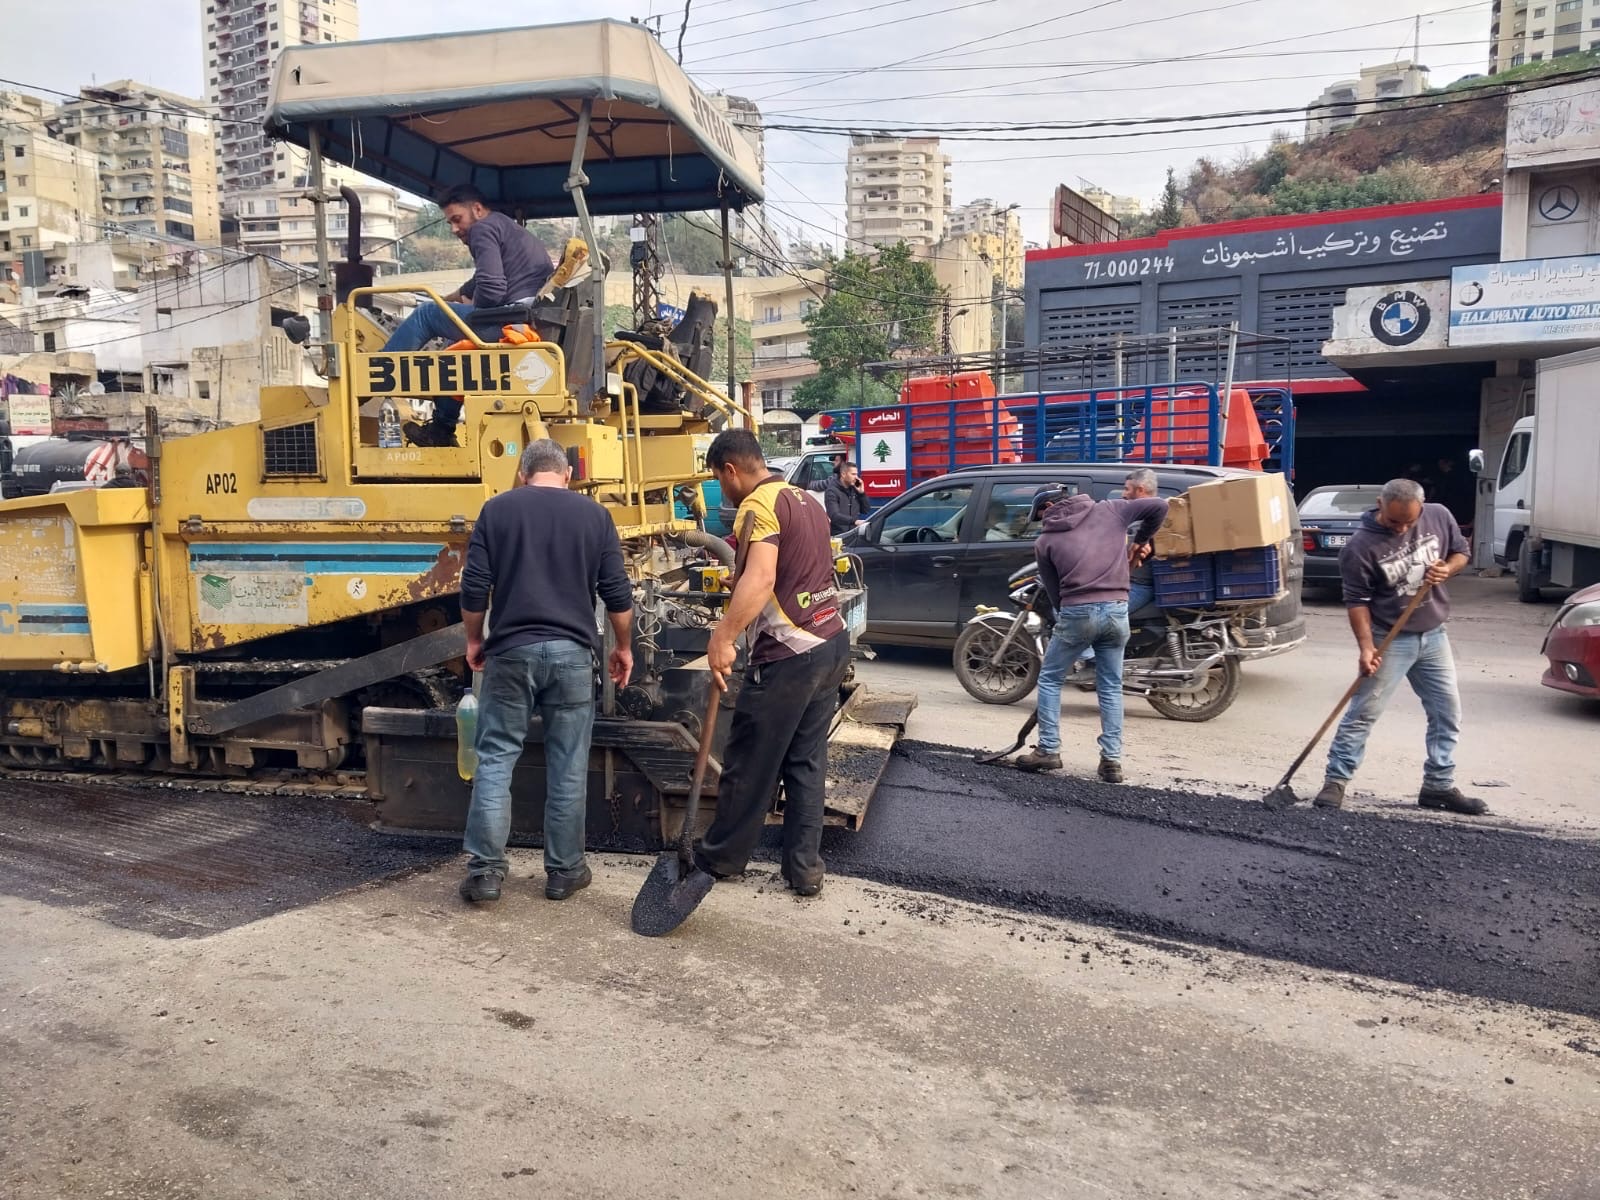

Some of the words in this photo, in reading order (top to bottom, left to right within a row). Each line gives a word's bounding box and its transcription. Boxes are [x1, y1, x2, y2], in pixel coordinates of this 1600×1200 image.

[1299, 231, 1381, 260] وتركيب
[1390, 221, 1448, 256] تصنيع
[1084, 256, 1174, 280] 71-000244
[1376, 291, 1426, 311] BMW
[1459, 308, 1529, 325] HALAWANI
[1528, 306, 1566, 321] AUTO
[369, 354, 511, 392] BITELLI
[868, 411, 900, 425] الحامي
[206, 473, 237, 494] AP02
[869, 479, 900, 488] الله
